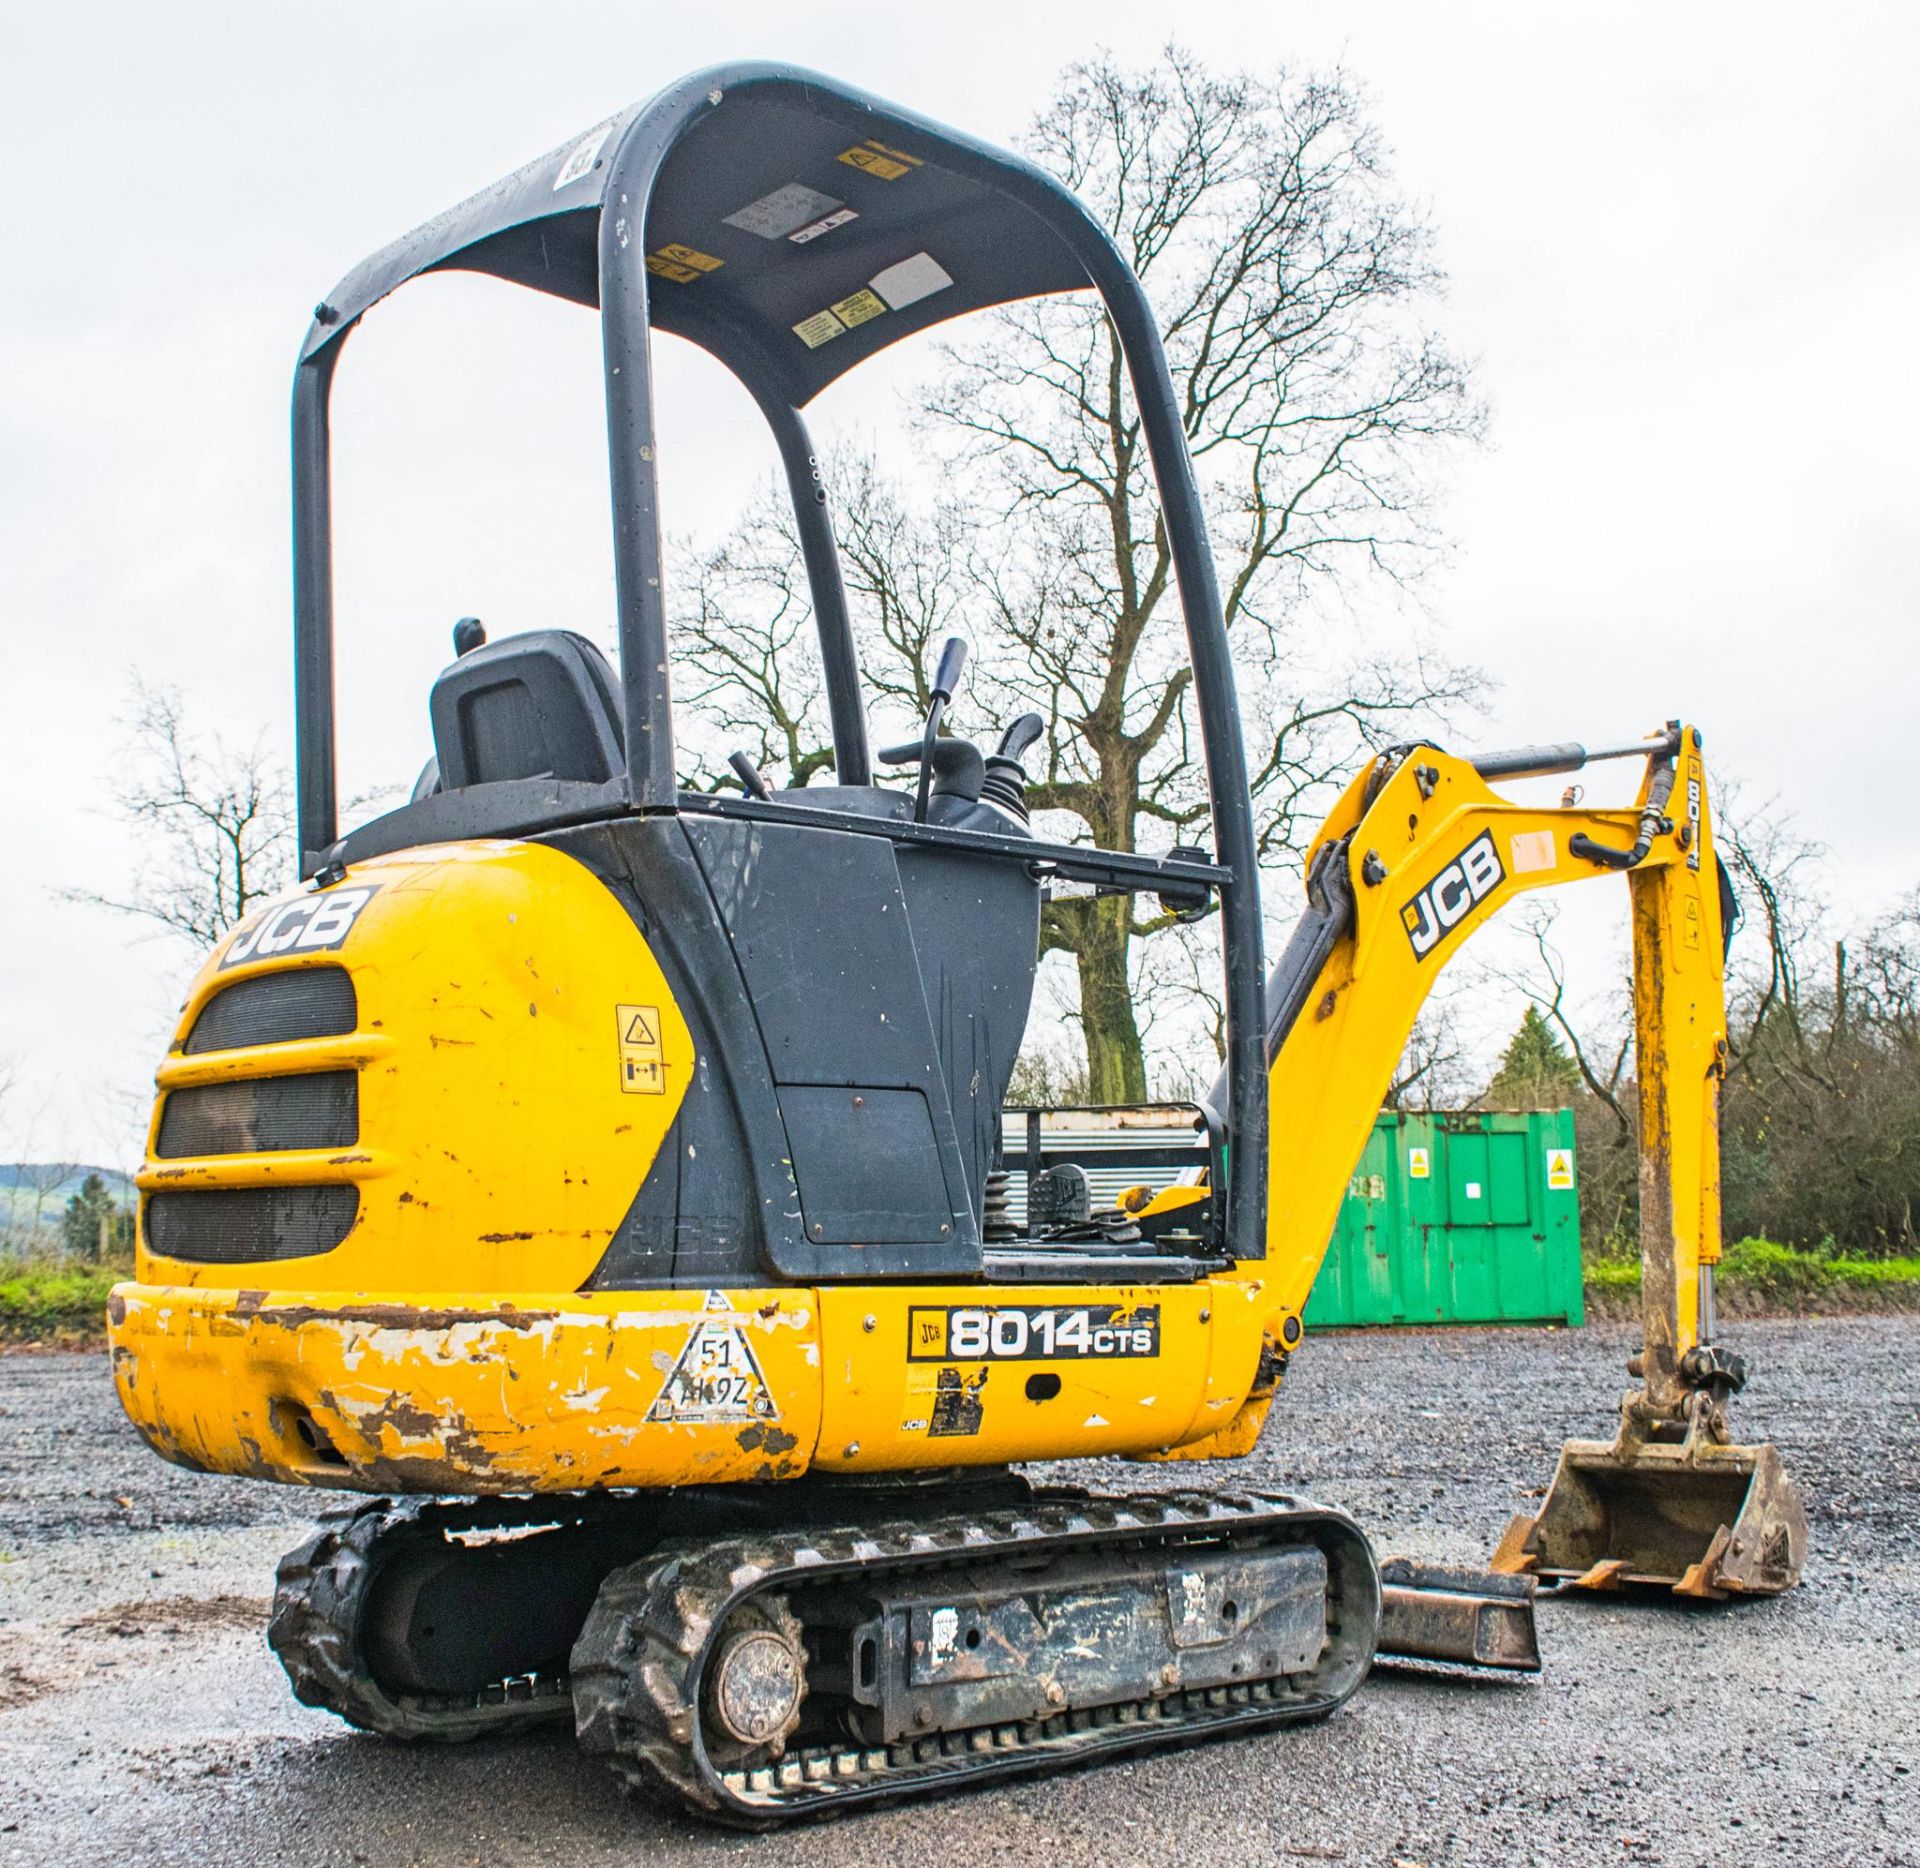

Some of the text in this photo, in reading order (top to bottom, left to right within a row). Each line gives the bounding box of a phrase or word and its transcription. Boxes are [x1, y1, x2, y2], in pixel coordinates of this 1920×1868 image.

[1411, 837, 1501, 953] JCB
[225, 889, 371, 963] JCB
[921, 1323, 941, 1344] JCB
[701, 1340, 732, 1368] 51
[901, 1419, 928, 1431] JCB
